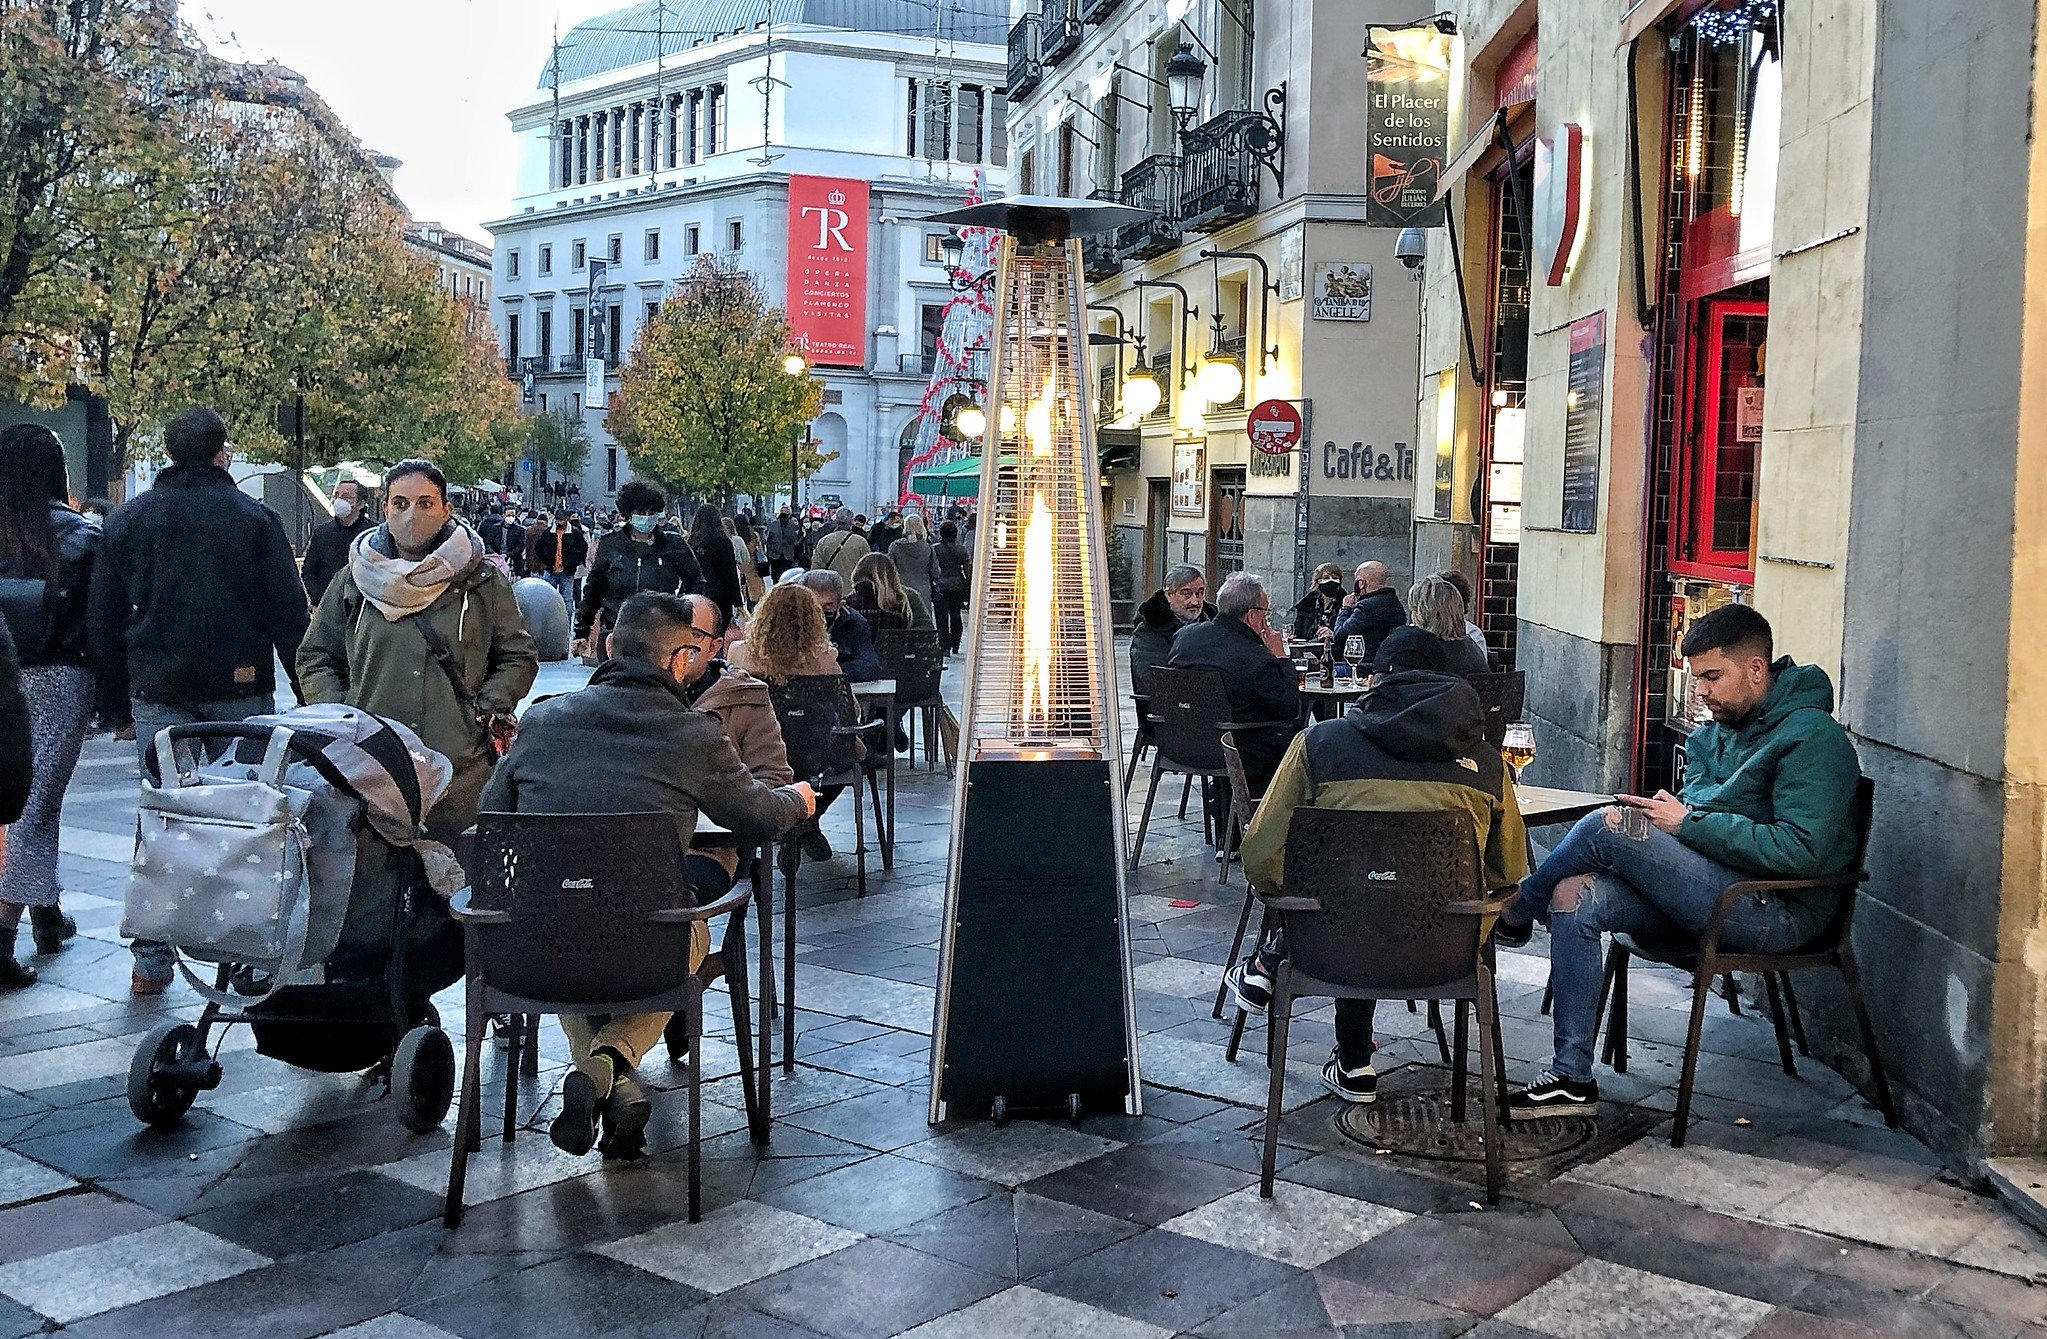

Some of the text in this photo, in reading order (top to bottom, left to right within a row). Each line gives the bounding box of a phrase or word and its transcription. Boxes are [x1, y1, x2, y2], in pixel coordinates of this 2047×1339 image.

[1375, 93, 1441, 109] El Placer
[1384, 112, 1431, 128] de los
[1373, 131, 1442, 147] Sentidos
[804, 279, 850, 288] DANZA
[803, 289, 850, 299] CONCIERTOS
[803, 310, 850, 319] VISITAS
[1314, 306, 1368, 319] ANGELES
